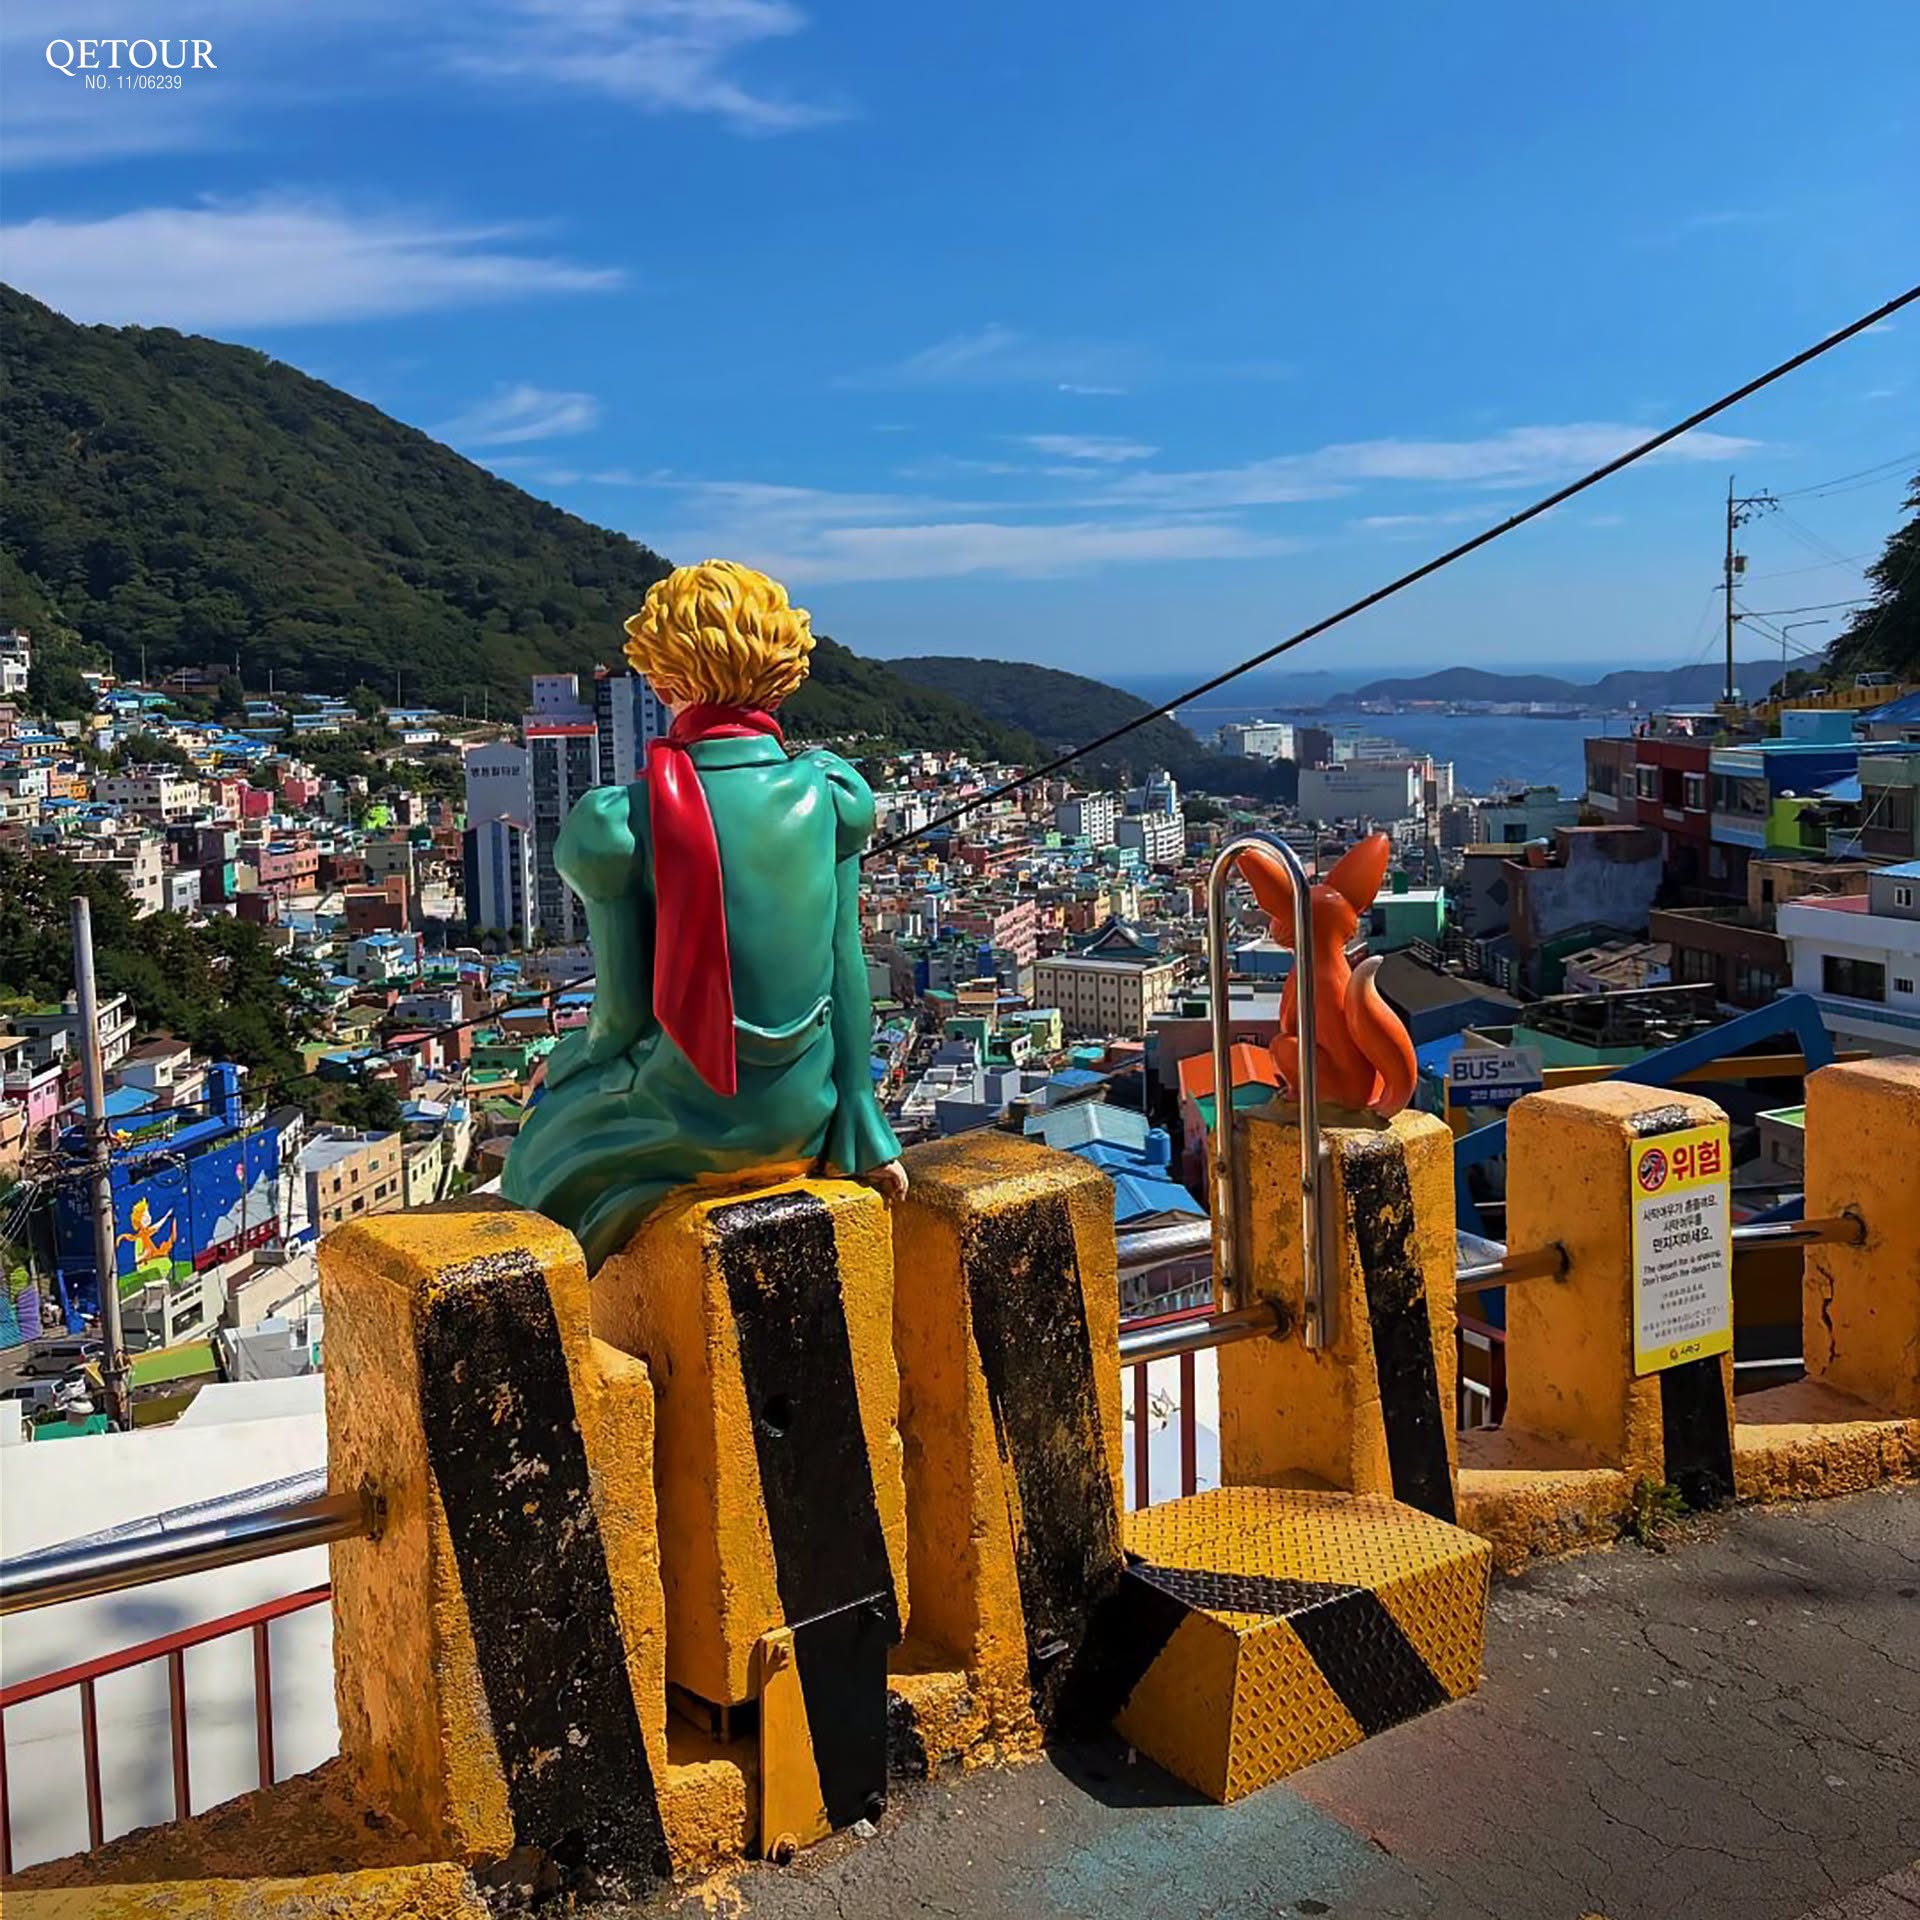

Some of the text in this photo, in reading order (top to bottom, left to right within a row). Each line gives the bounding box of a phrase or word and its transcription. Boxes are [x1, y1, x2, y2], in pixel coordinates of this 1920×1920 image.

[1671, 1139, 1721, 1181] 위험
[1643, 1202, 1683, 1221] 사막여우가
[1652, 1226, 1713, 1253] 만지지마세요.
